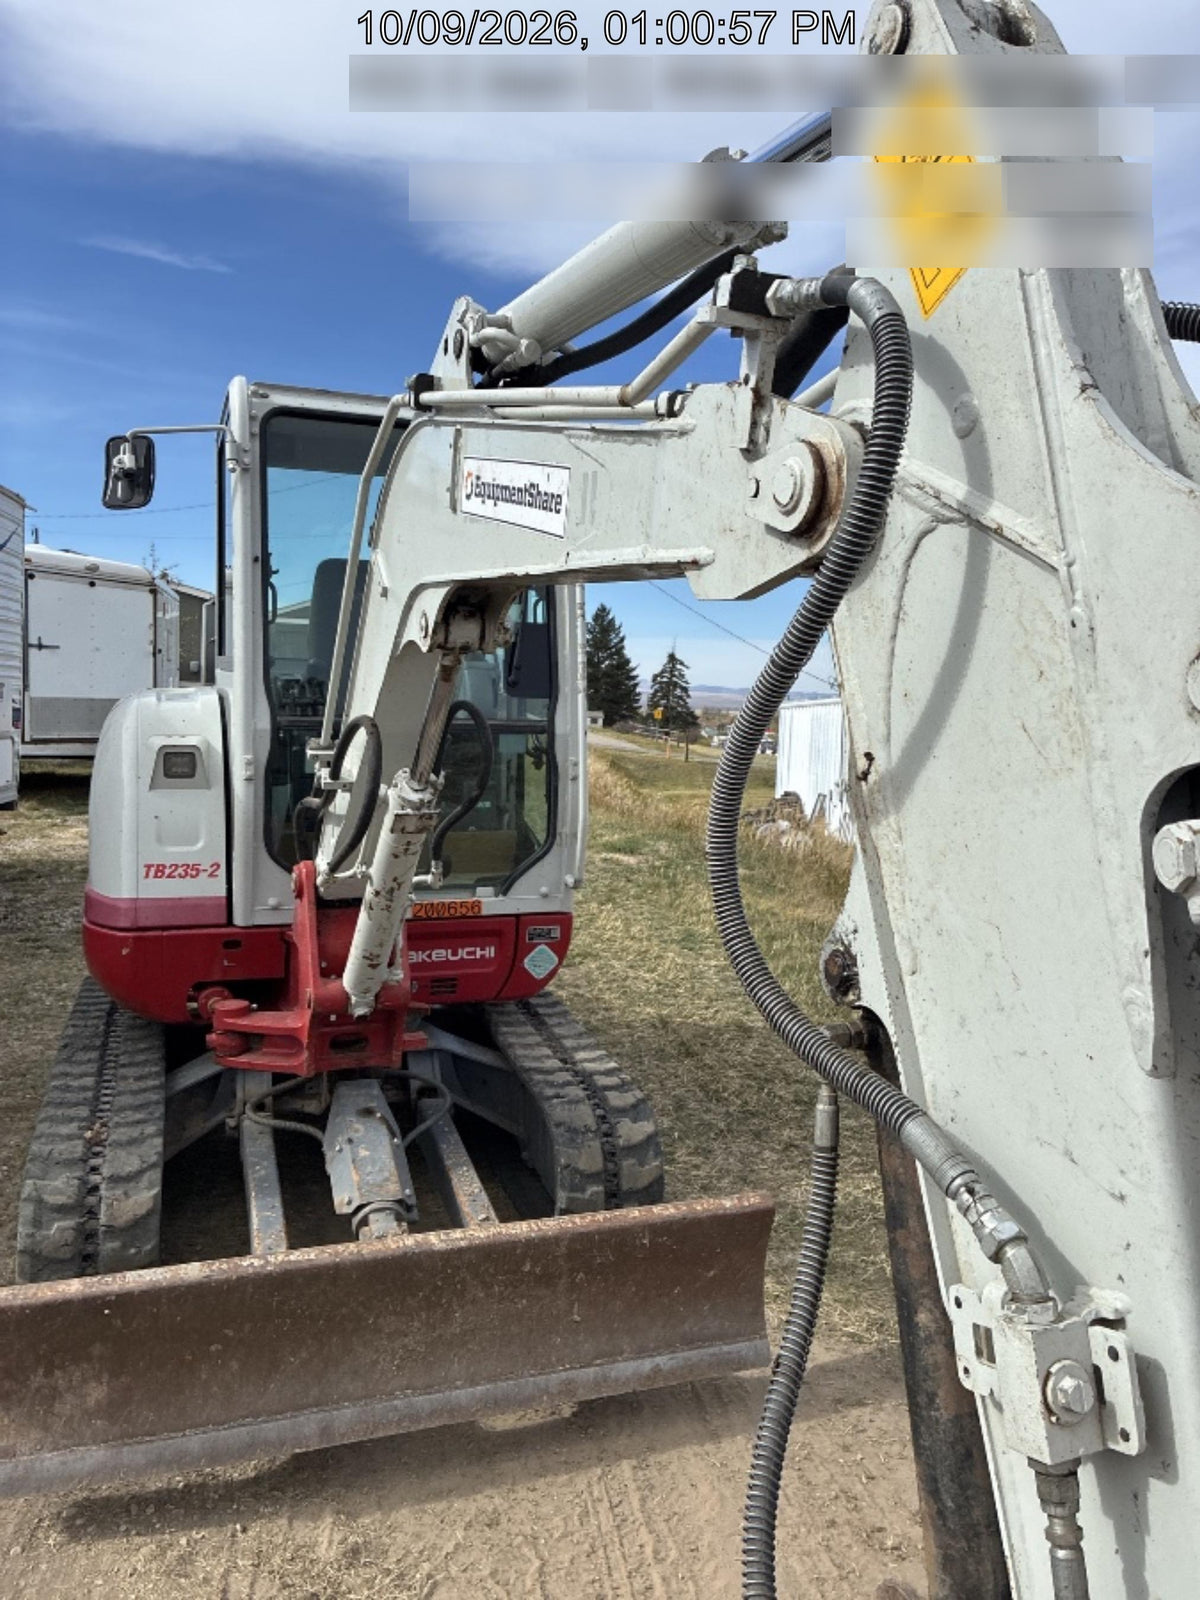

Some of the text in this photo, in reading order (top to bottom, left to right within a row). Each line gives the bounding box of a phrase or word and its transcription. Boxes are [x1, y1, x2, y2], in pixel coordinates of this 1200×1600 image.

[474, 475, 562, 514] EquipmentShare
[143, 862, 221, 879] TB235-2
[413, 900, 482, 917] 200656
